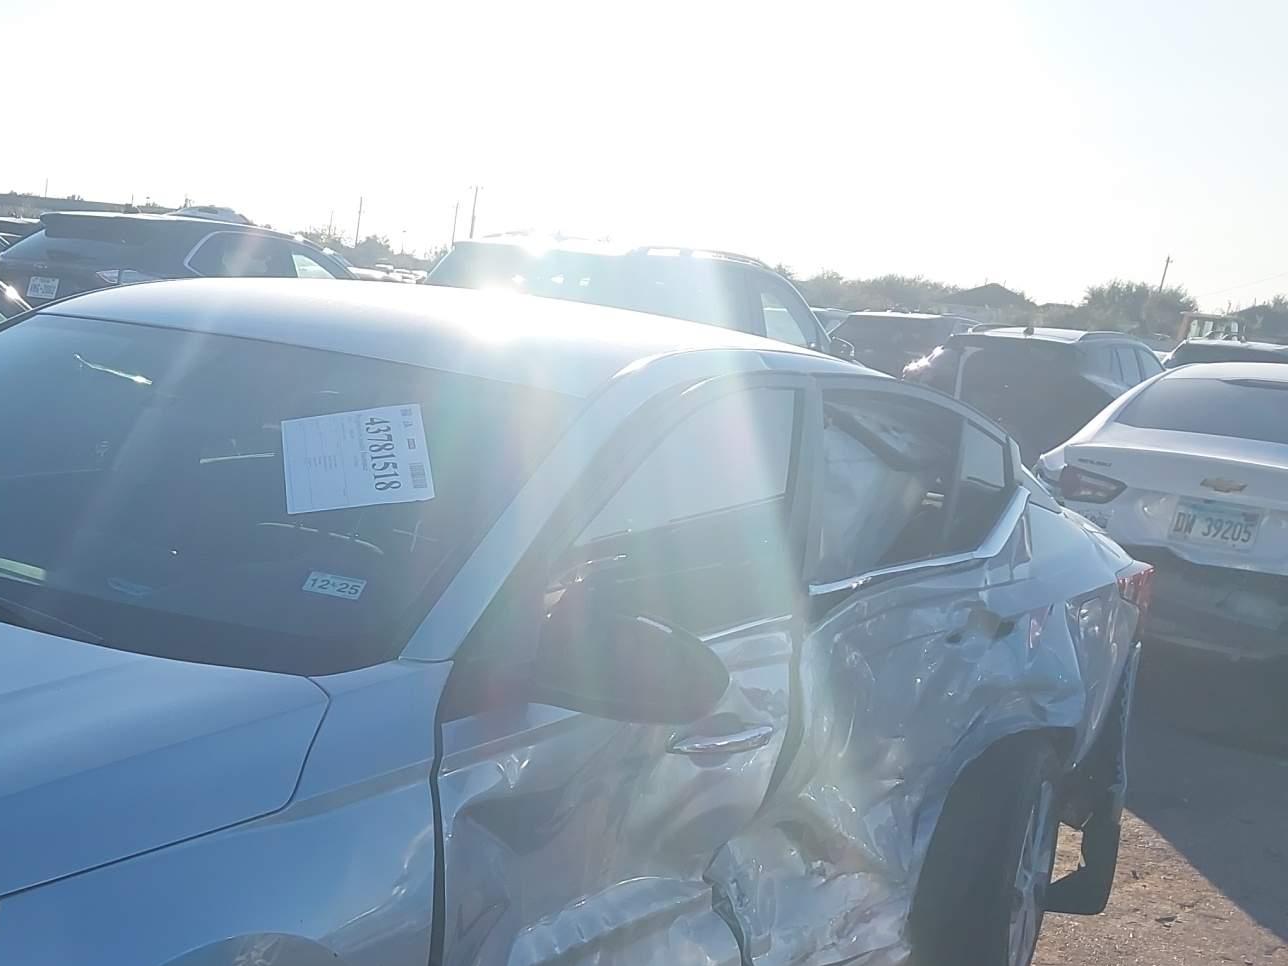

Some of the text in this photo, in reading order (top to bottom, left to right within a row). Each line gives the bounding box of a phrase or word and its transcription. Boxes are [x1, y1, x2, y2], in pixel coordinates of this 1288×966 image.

[365, 417, 402, 491] 43781518
[1201, 517, 1254, 543] 39205
[310, 578, 361, 595] 12 25
